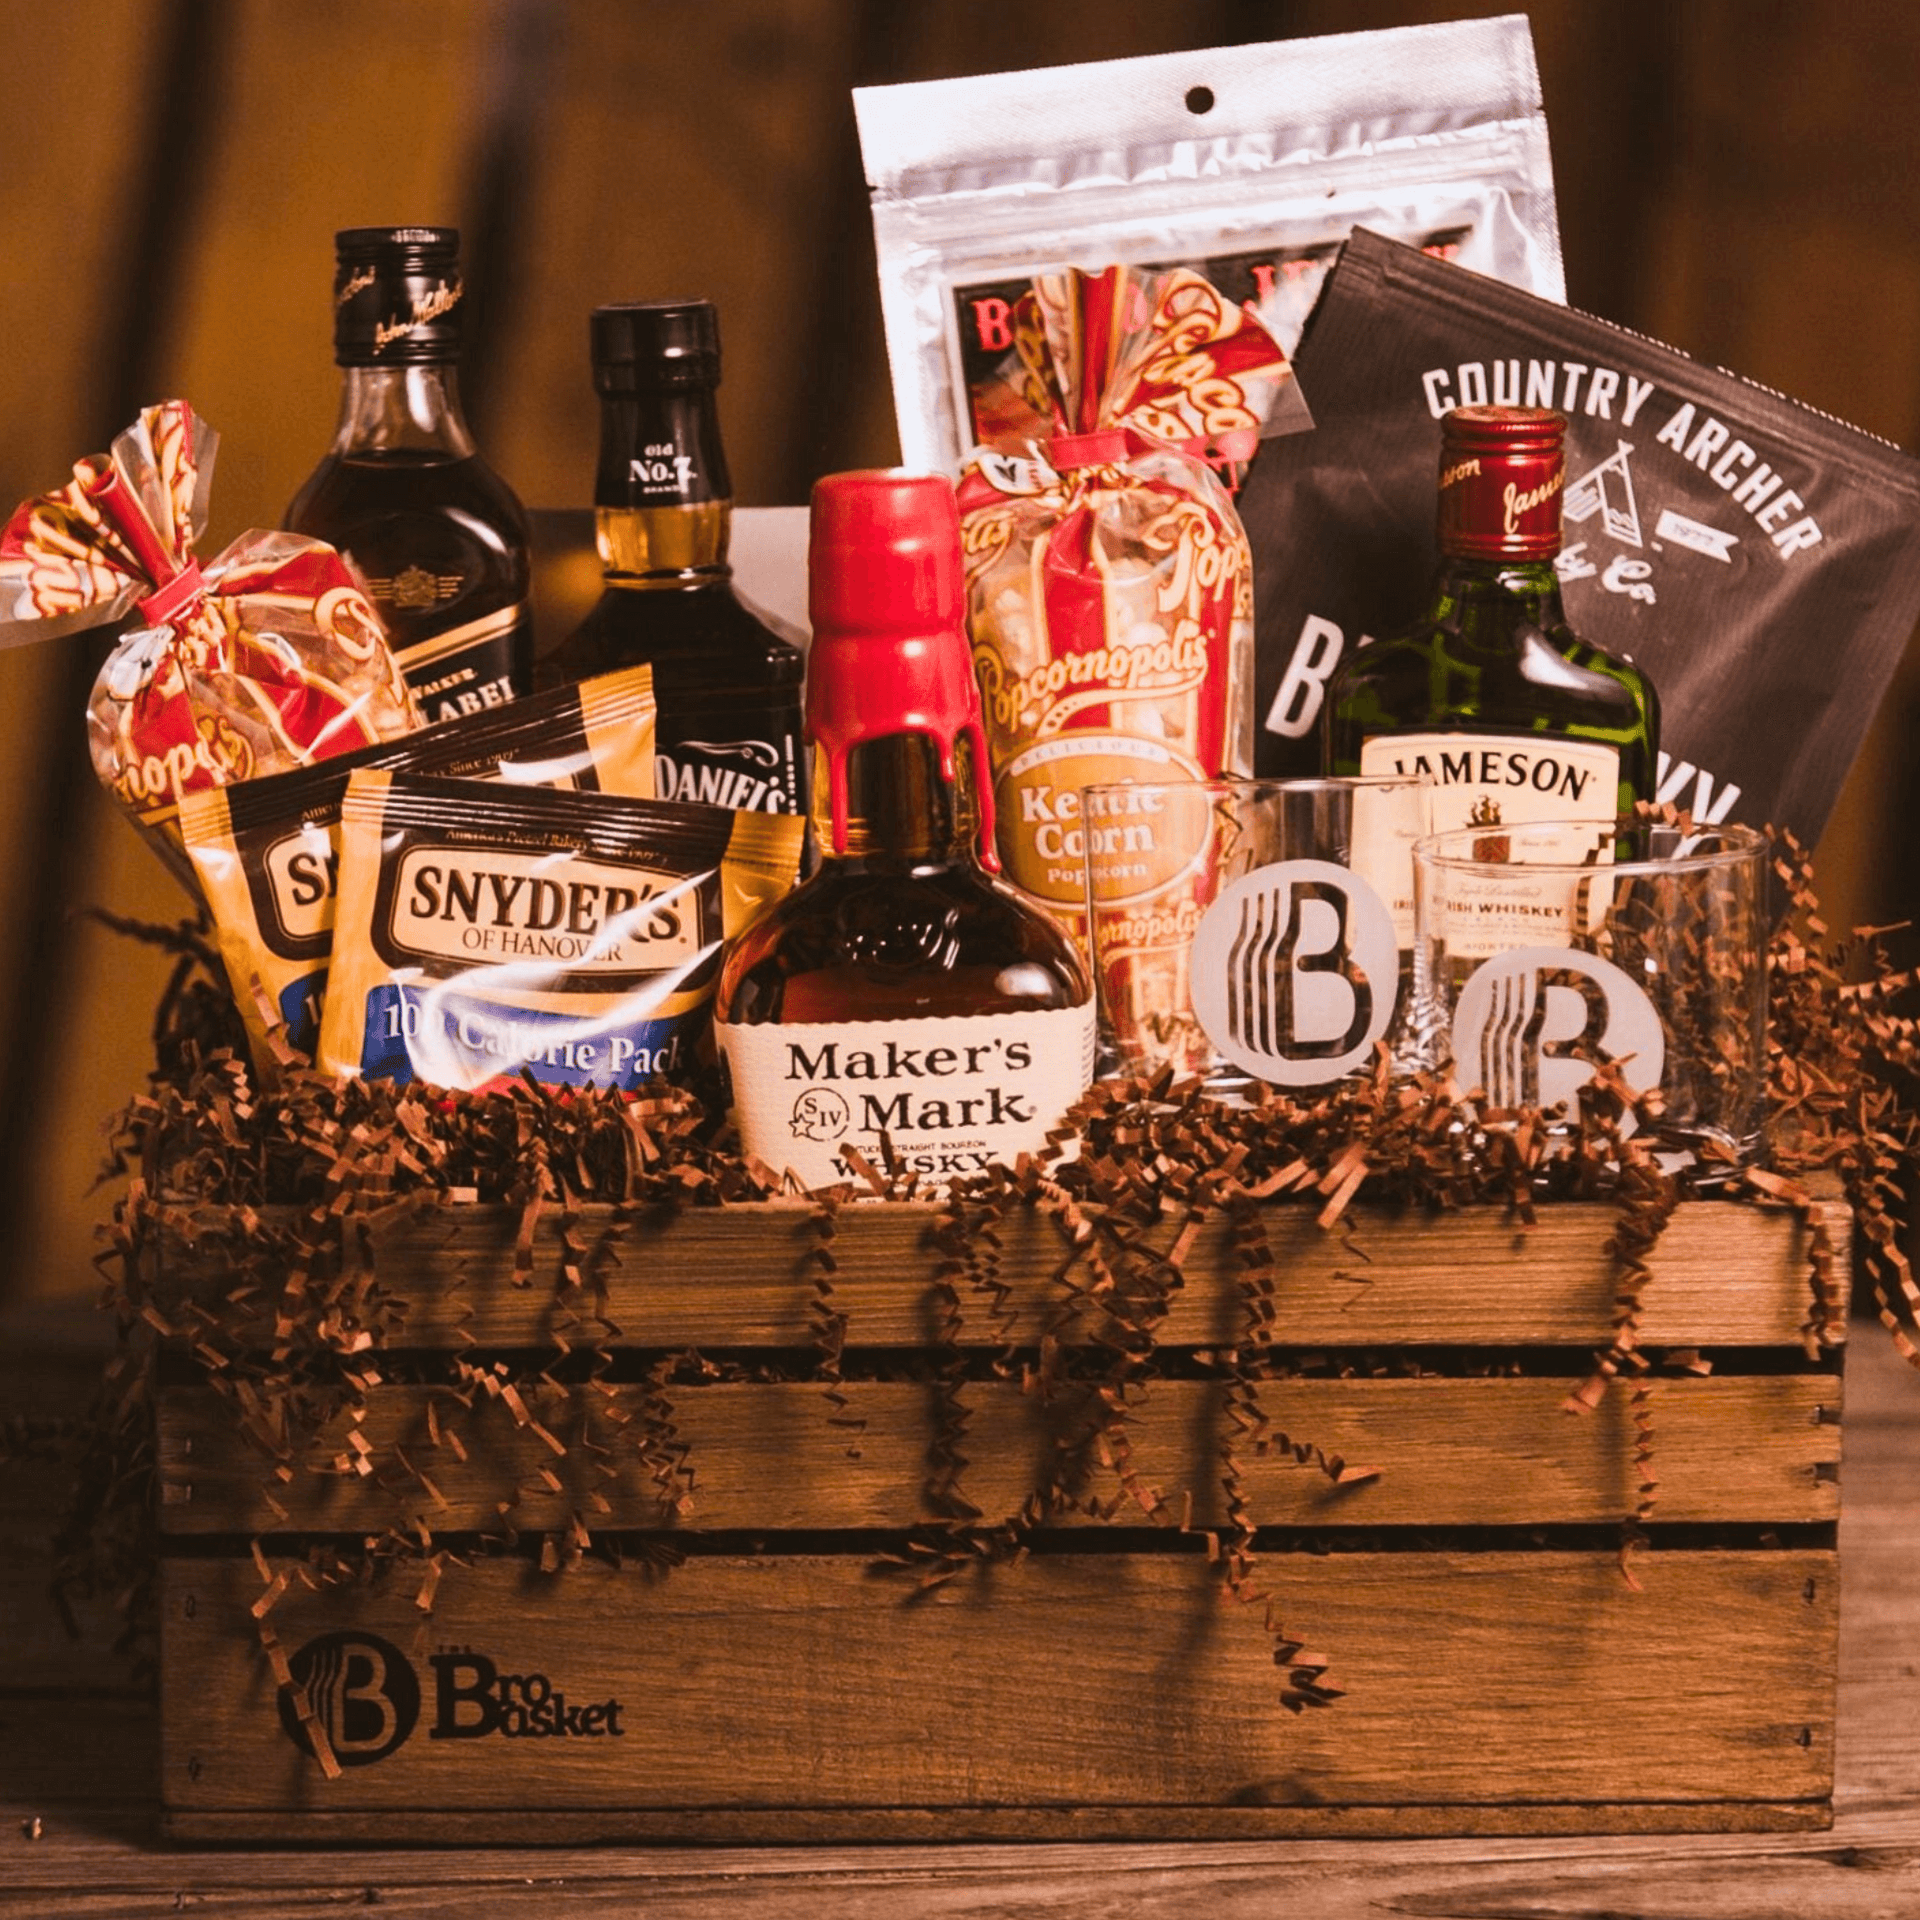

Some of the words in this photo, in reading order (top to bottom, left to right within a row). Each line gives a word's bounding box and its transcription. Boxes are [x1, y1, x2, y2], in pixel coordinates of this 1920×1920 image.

[1422, 359, 1655, 427] COUNTRY
[1656, 402, 1823, 561] ARCHER
[1395, 751, 1590, 802] JAMESON
[1035, 824, 1154, 860] Corn
[409, 865, 684, 944] SNYDER'S
[1479, 903, 1564, 917] WHISKEY
[462, 927, 495, 949] OF
[501, 931, 624, 962] HANOVER
[785, 1038, 1033, 1080] Maker's
[858, 1088, 1034, 1132] Mark
